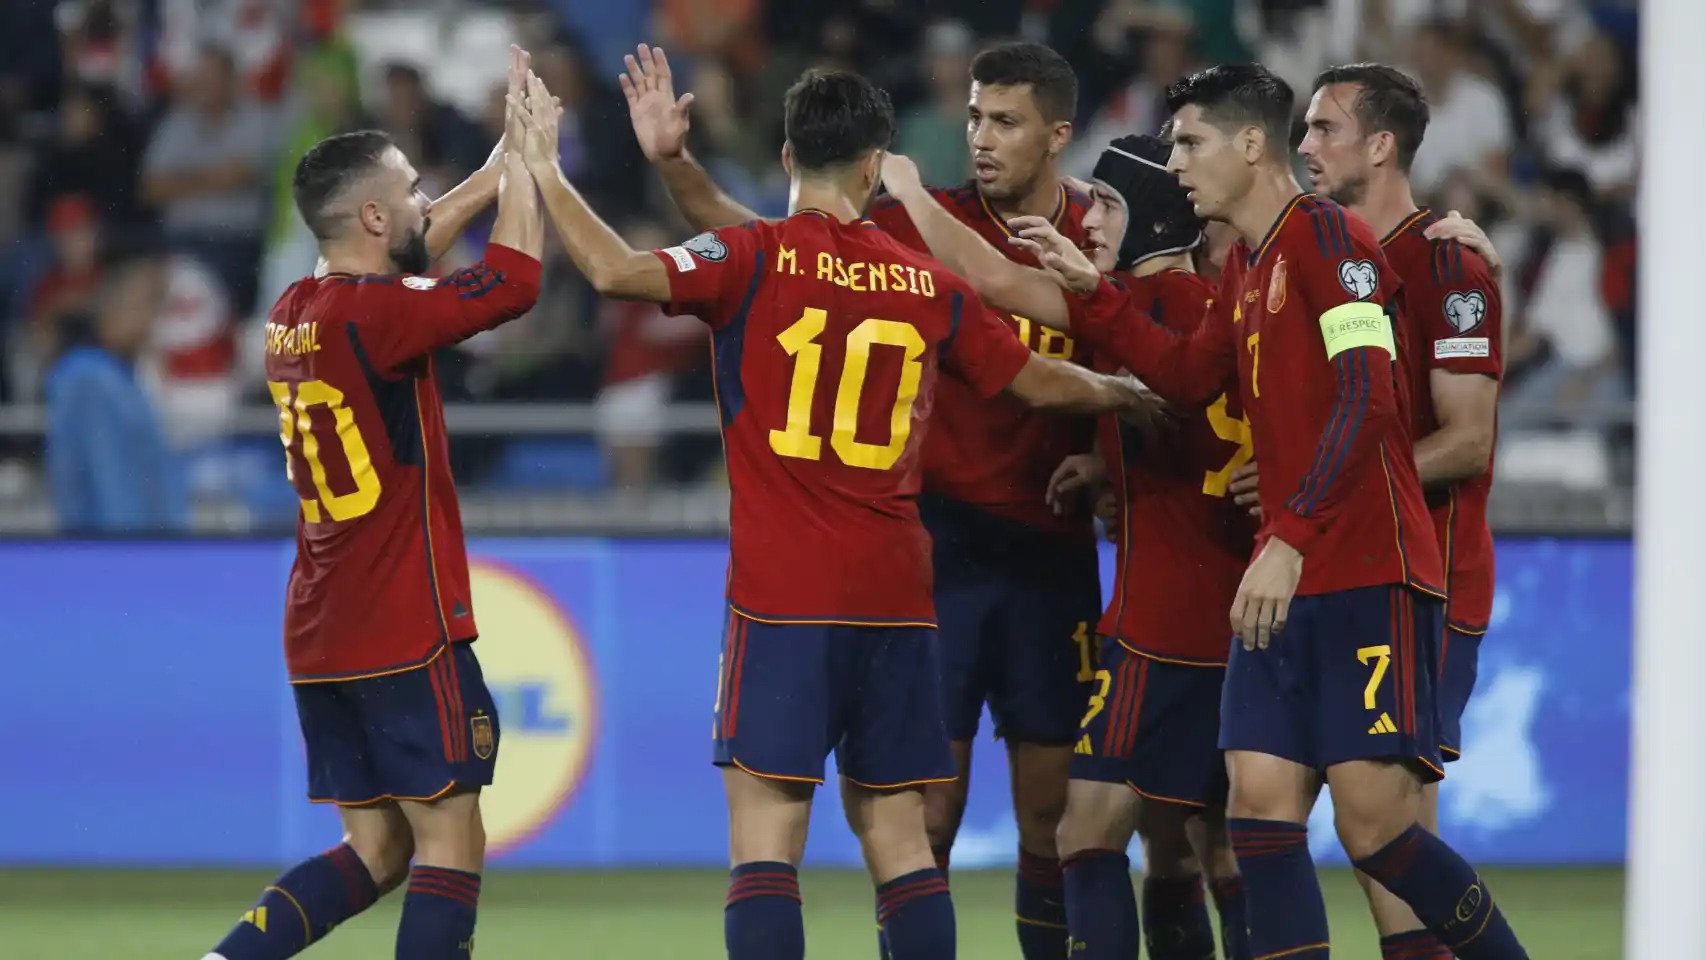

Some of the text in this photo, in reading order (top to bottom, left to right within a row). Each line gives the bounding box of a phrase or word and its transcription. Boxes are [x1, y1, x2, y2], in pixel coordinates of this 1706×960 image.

[776, 243, 936, 298] M. ASENSIO
[1339, 319, 1382, 333] RESPECT
[769, 306, 925, 470] 10
[1247, 331, 1260, 398] 7
[1357, 644, 1391, 710] 7
